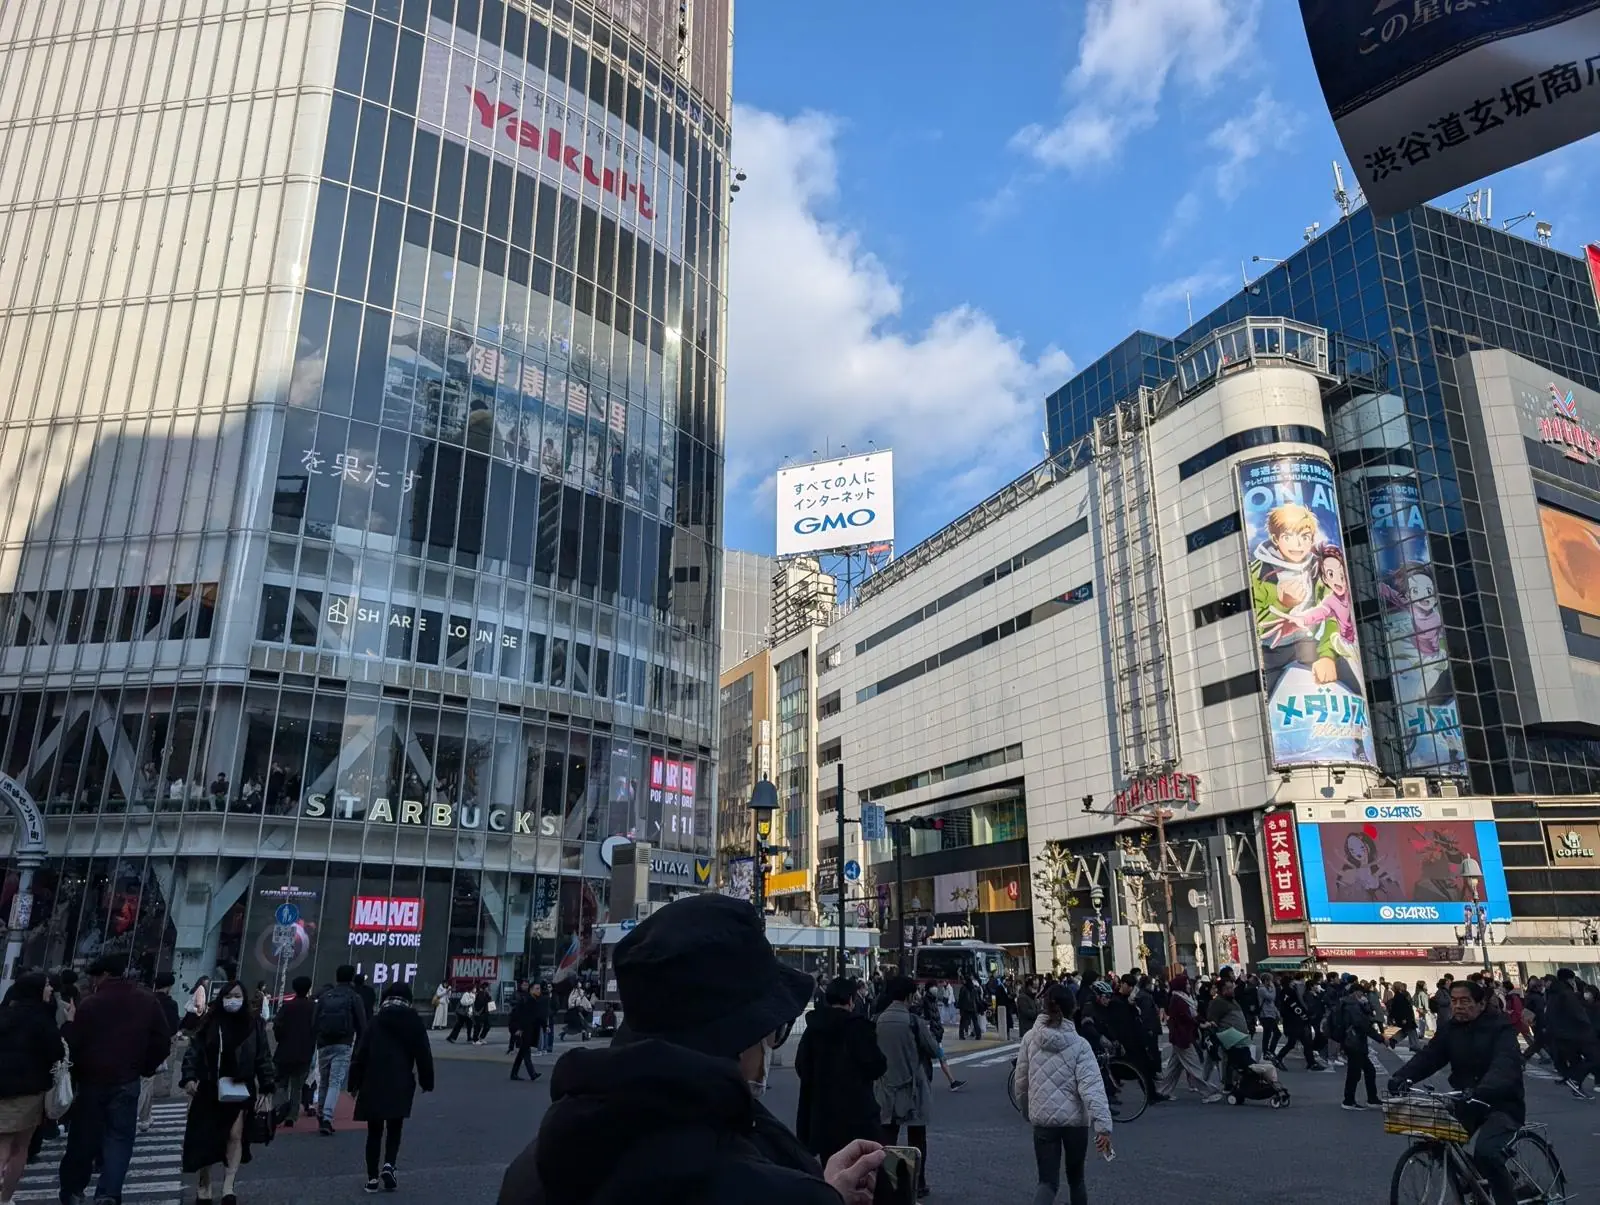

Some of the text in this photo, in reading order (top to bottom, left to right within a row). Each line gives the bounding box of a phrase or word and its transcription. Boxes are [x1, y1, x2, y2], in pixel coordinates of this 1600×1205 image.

[464, 84, 658, 220] Yakult
[301, 449, 422, 493] を果たす
[793, 471, 876, 496] すべての人に
[793, 488, 876, 511] インターネット
[1245, 482, 1304, 513] ON
[793, 508, 876, 535] GMO
[357, 608, 518, 649] SHARE LOUNGE
[1115, 772, 1201, 816] MAGNET
[306, 792, 557, 837] STARBUCKS
[1557, 848, 1595, 858] COFFEE
[649, 859, 690, 877] SUTAYA
[1271, 830, 1297, 913] 天津甘栗
[354, 899, 420, 927] MARVEL
[347, 932, 421, 947] POP-UP STORE
[1269, 937, 1305, 951] 天津甘栗
[373, 962, 418, 984] B1F
[452, 958, 497, 979] MARVEL
